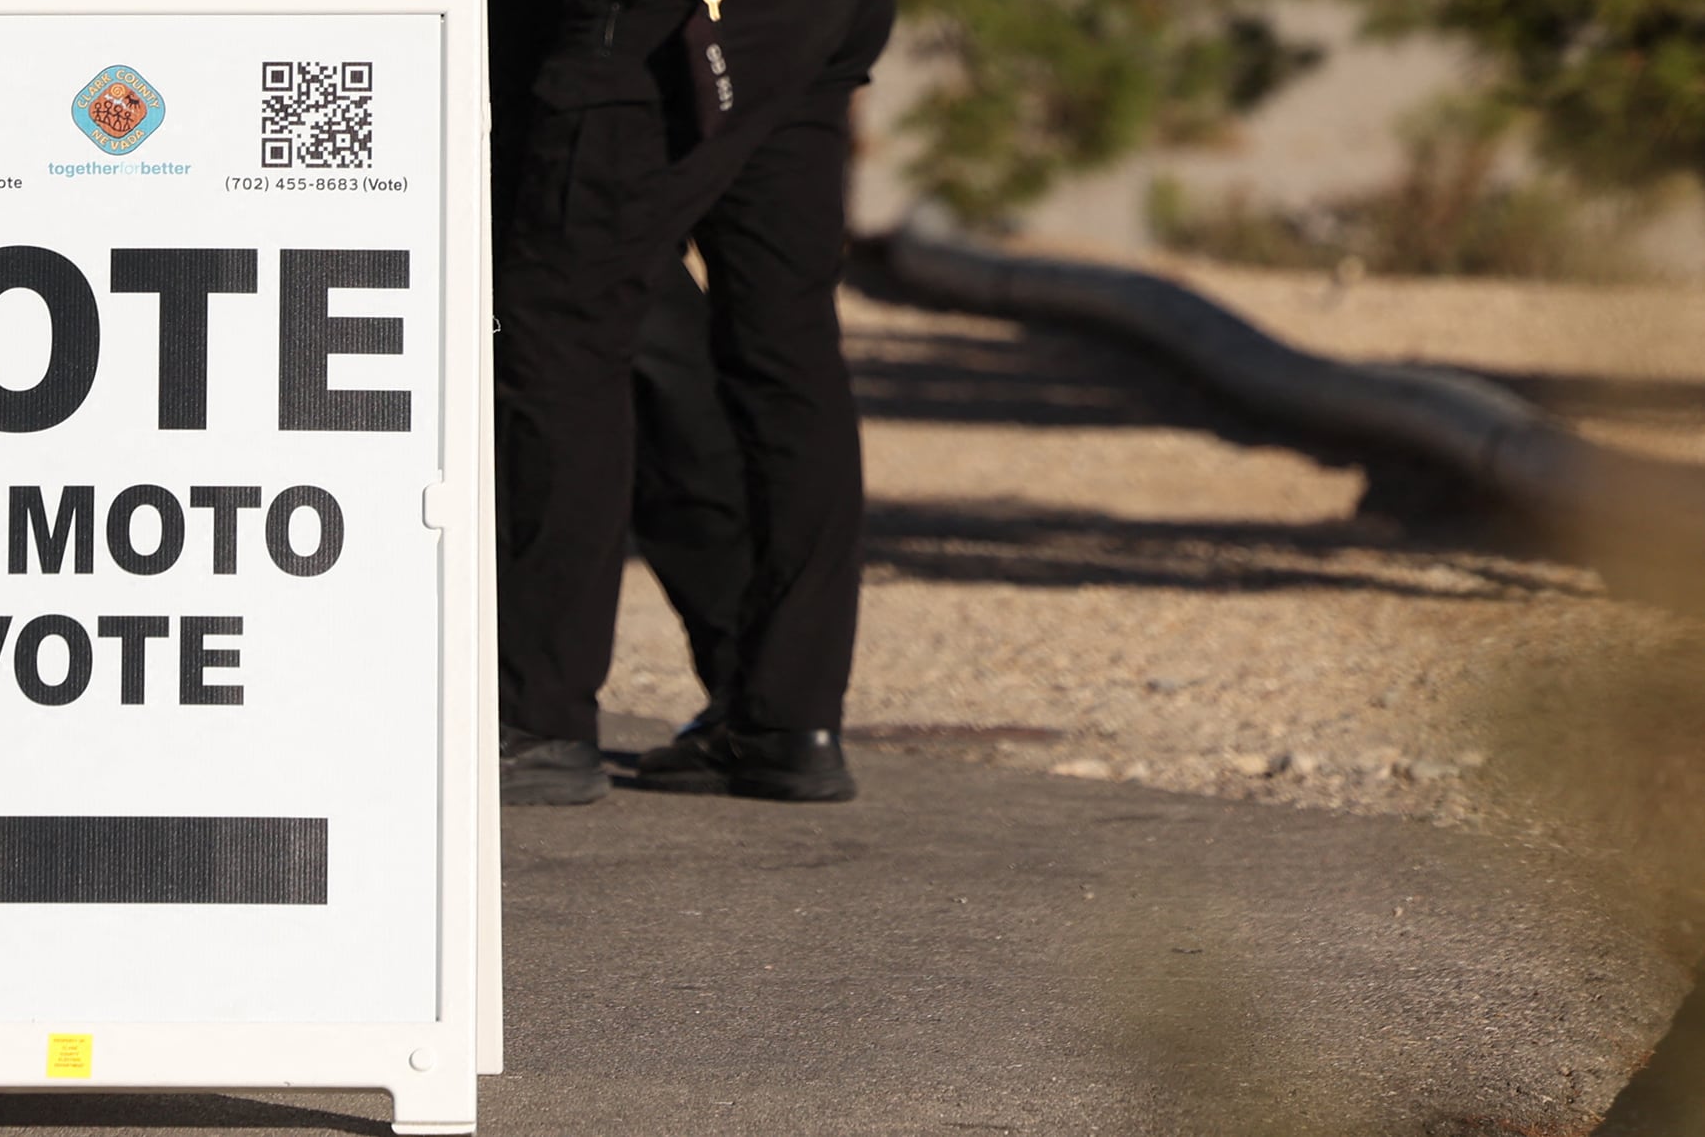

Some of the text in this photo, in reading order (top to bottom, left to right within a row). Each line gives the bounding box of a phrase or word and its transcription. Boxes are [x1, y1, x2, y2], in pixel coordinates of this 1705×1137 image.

[77, 69, 160, 110] CLARK COUNTY
[91, 129, 145, 151] NEVADA
[225, 176, 408, 193] (702) 455-8683 (Vote)
